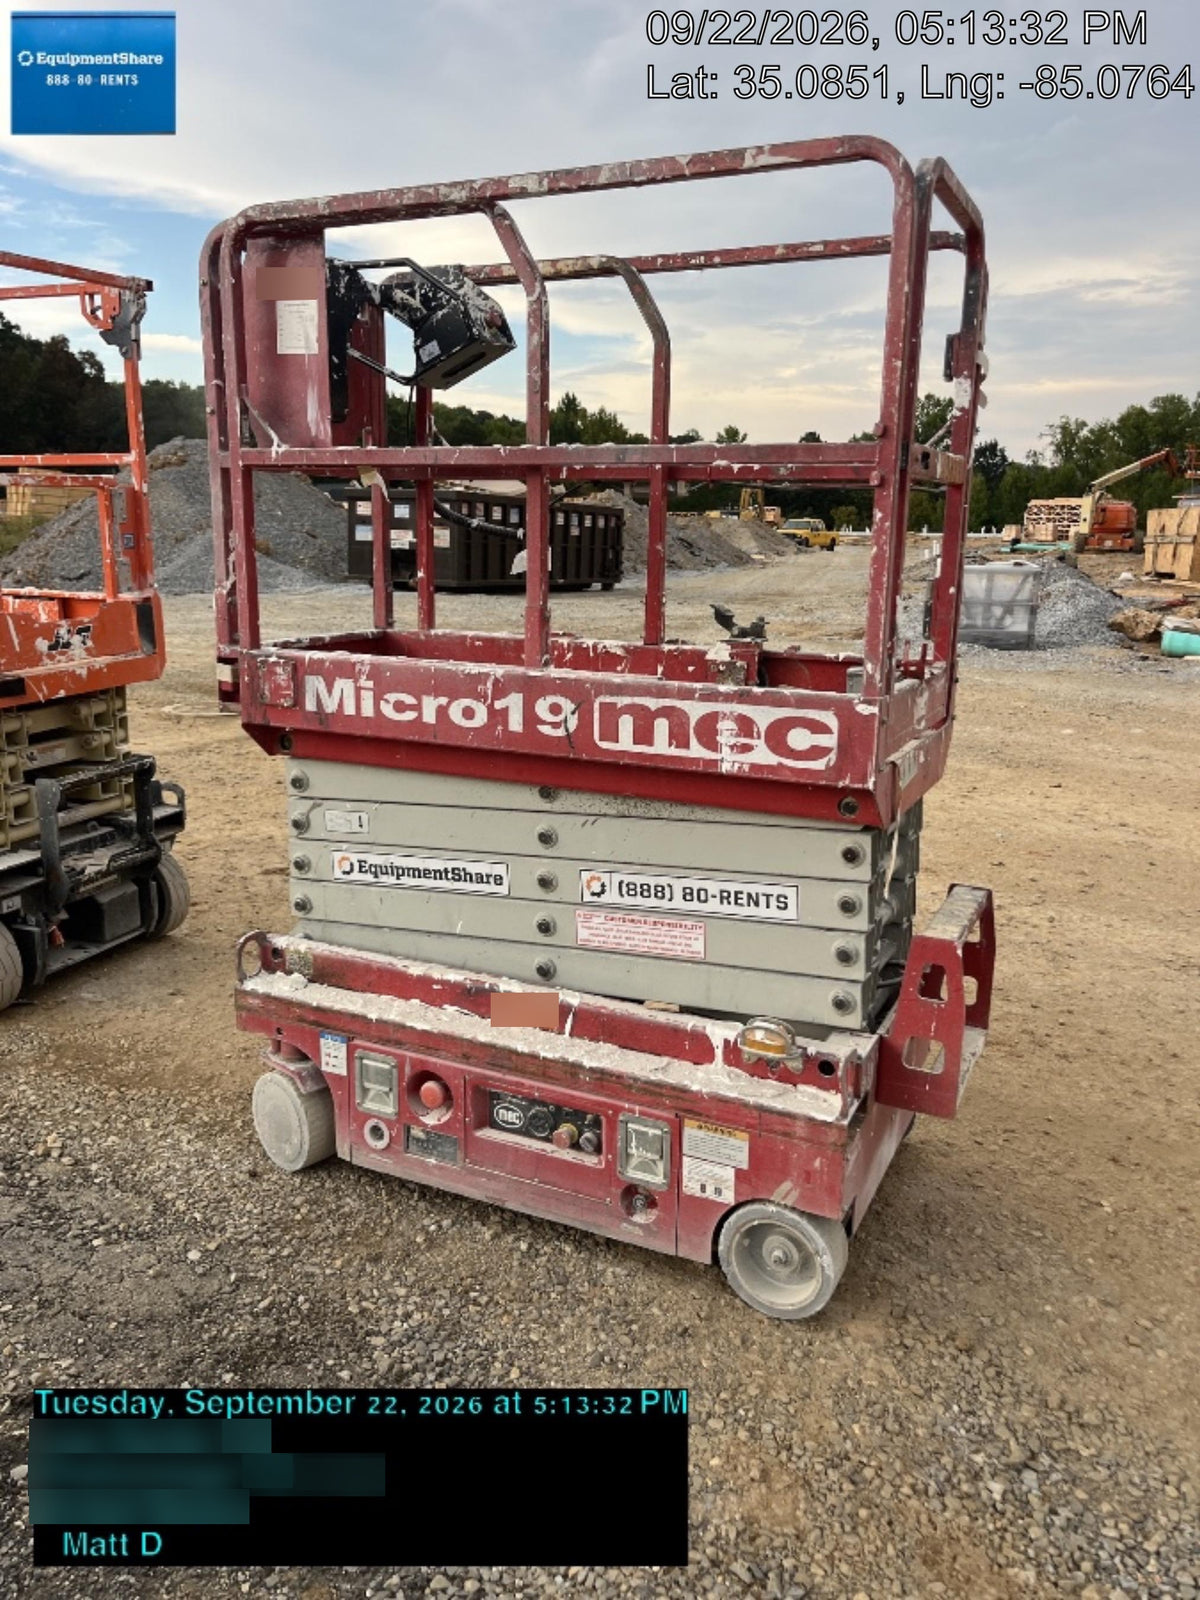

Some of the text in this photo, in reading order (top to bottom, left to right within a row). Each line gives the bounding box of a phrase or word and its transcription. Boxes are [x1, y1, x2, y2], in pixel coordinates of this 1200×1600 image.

[304, 674, 578, 737] Micro19
[357, 859, 504, 886] EquipmentShare
[618, 879, 789, 912] (888) 80-RENTS
